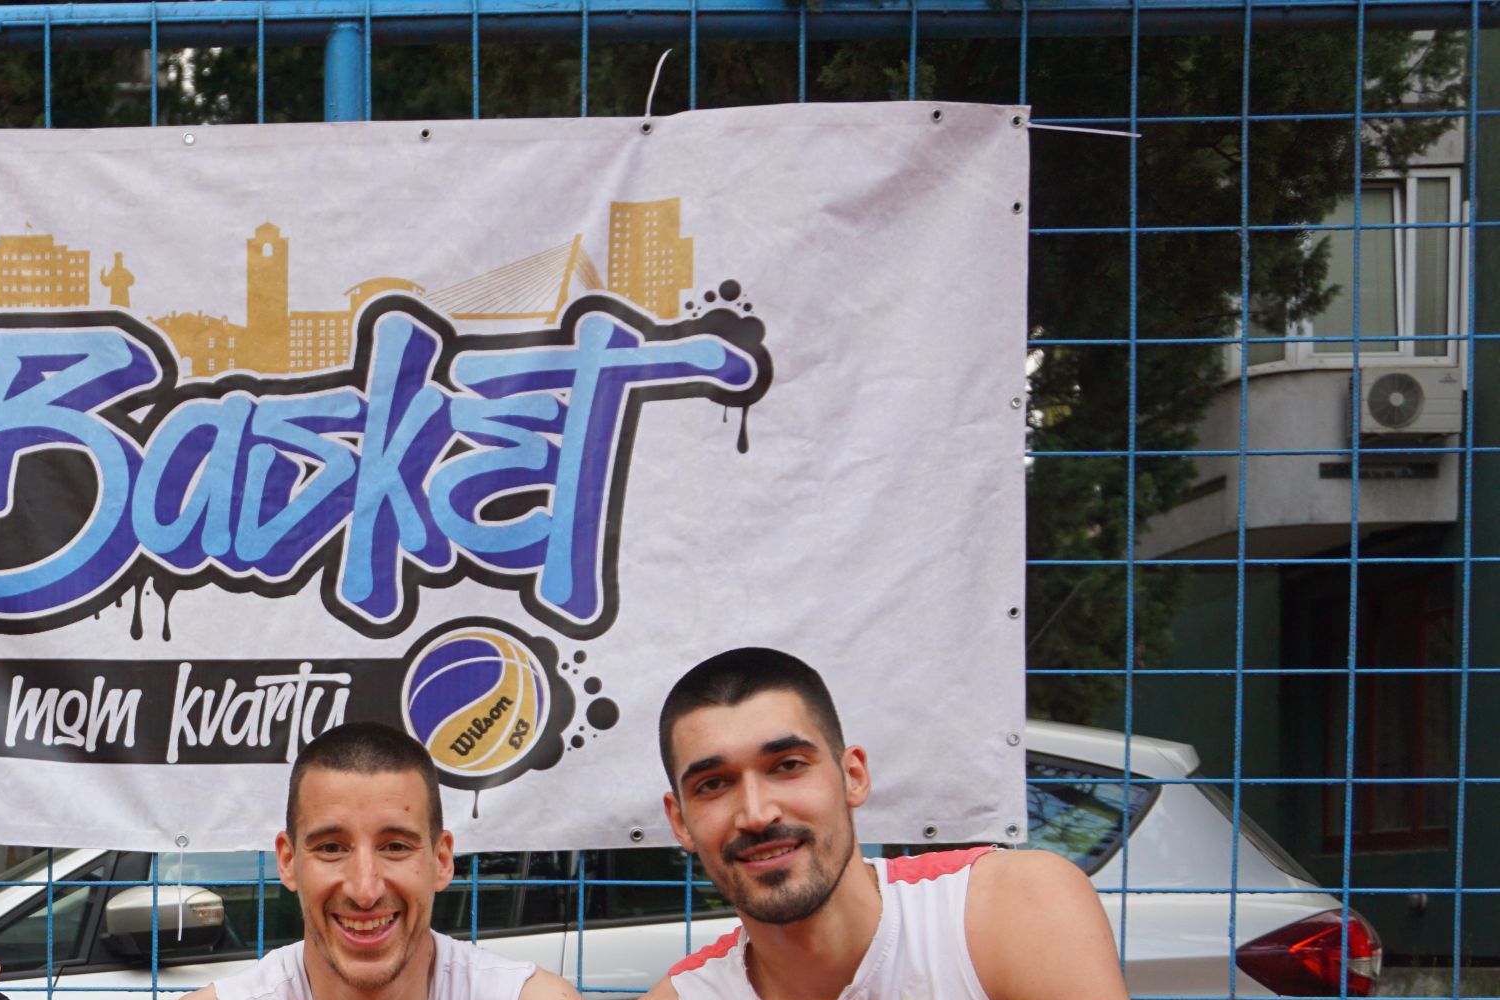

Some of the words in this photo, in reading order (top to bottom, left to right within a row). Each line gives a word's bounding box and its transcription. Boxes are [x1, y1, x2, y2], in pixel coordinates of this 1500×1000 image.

[4, 674, 143, 752] mom
[166, 661, 352, 764] kvartu
[450, 696, 514, 757] Wilson
